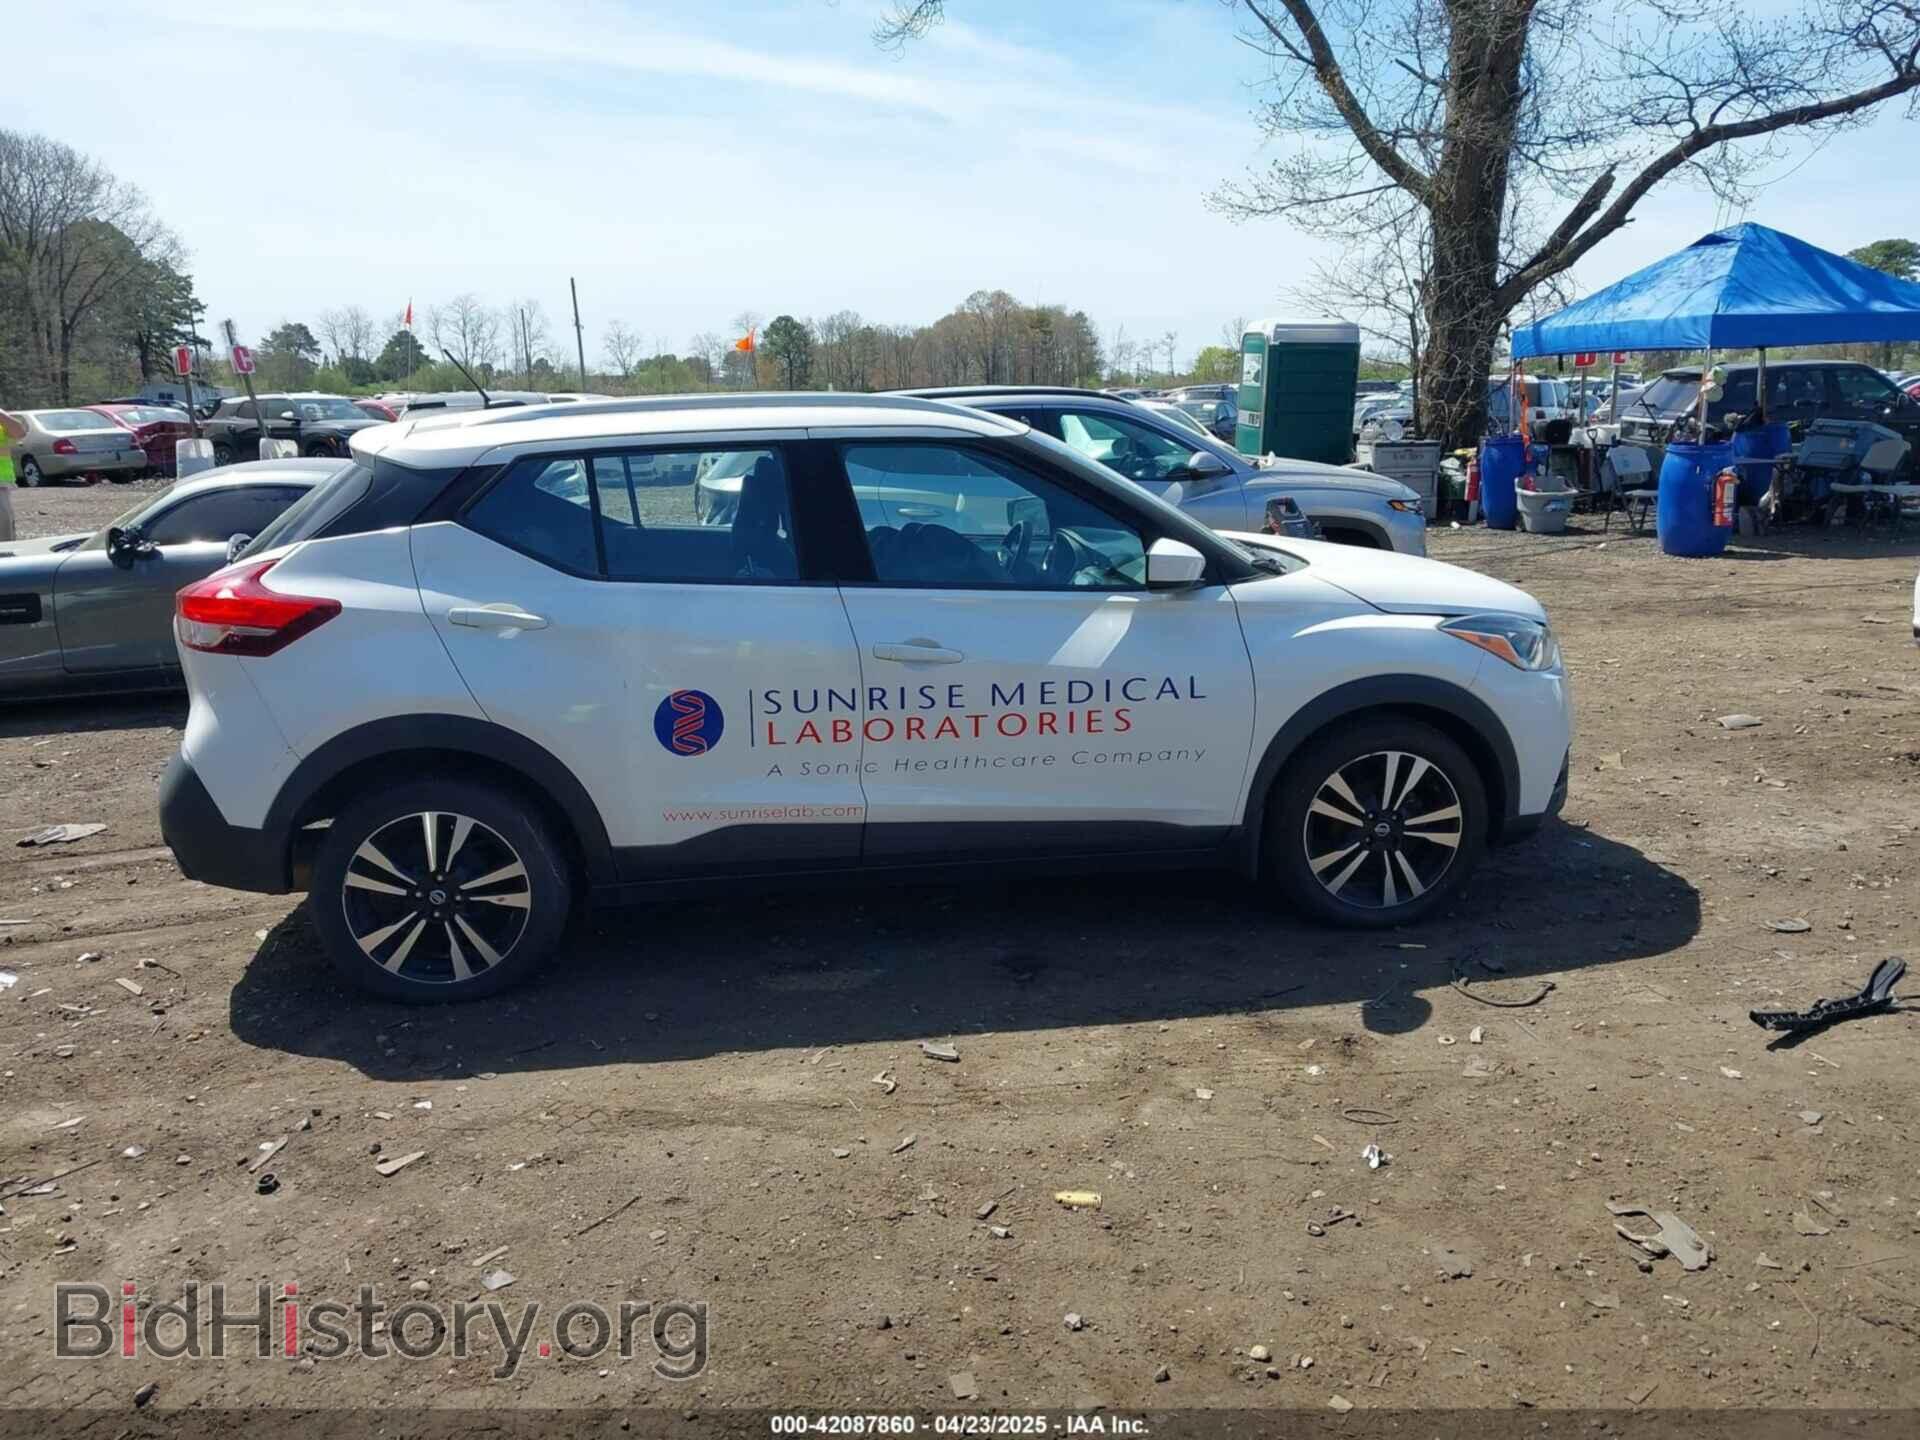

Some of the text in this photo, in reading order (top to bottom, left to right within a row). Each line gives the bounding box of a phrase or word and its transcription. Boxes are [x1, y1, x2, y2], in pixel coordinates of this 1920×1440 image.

[233, 345, 254, 372] C
[763, 675, 1208, 715] SUNRISE MEDICAL
[767, 708, 1132, 746] LABORATORIES
[767, 747, 1207, 777] A Sonic Healthcare Company
[662, 804, 865, 822] www.sunriselab.com
